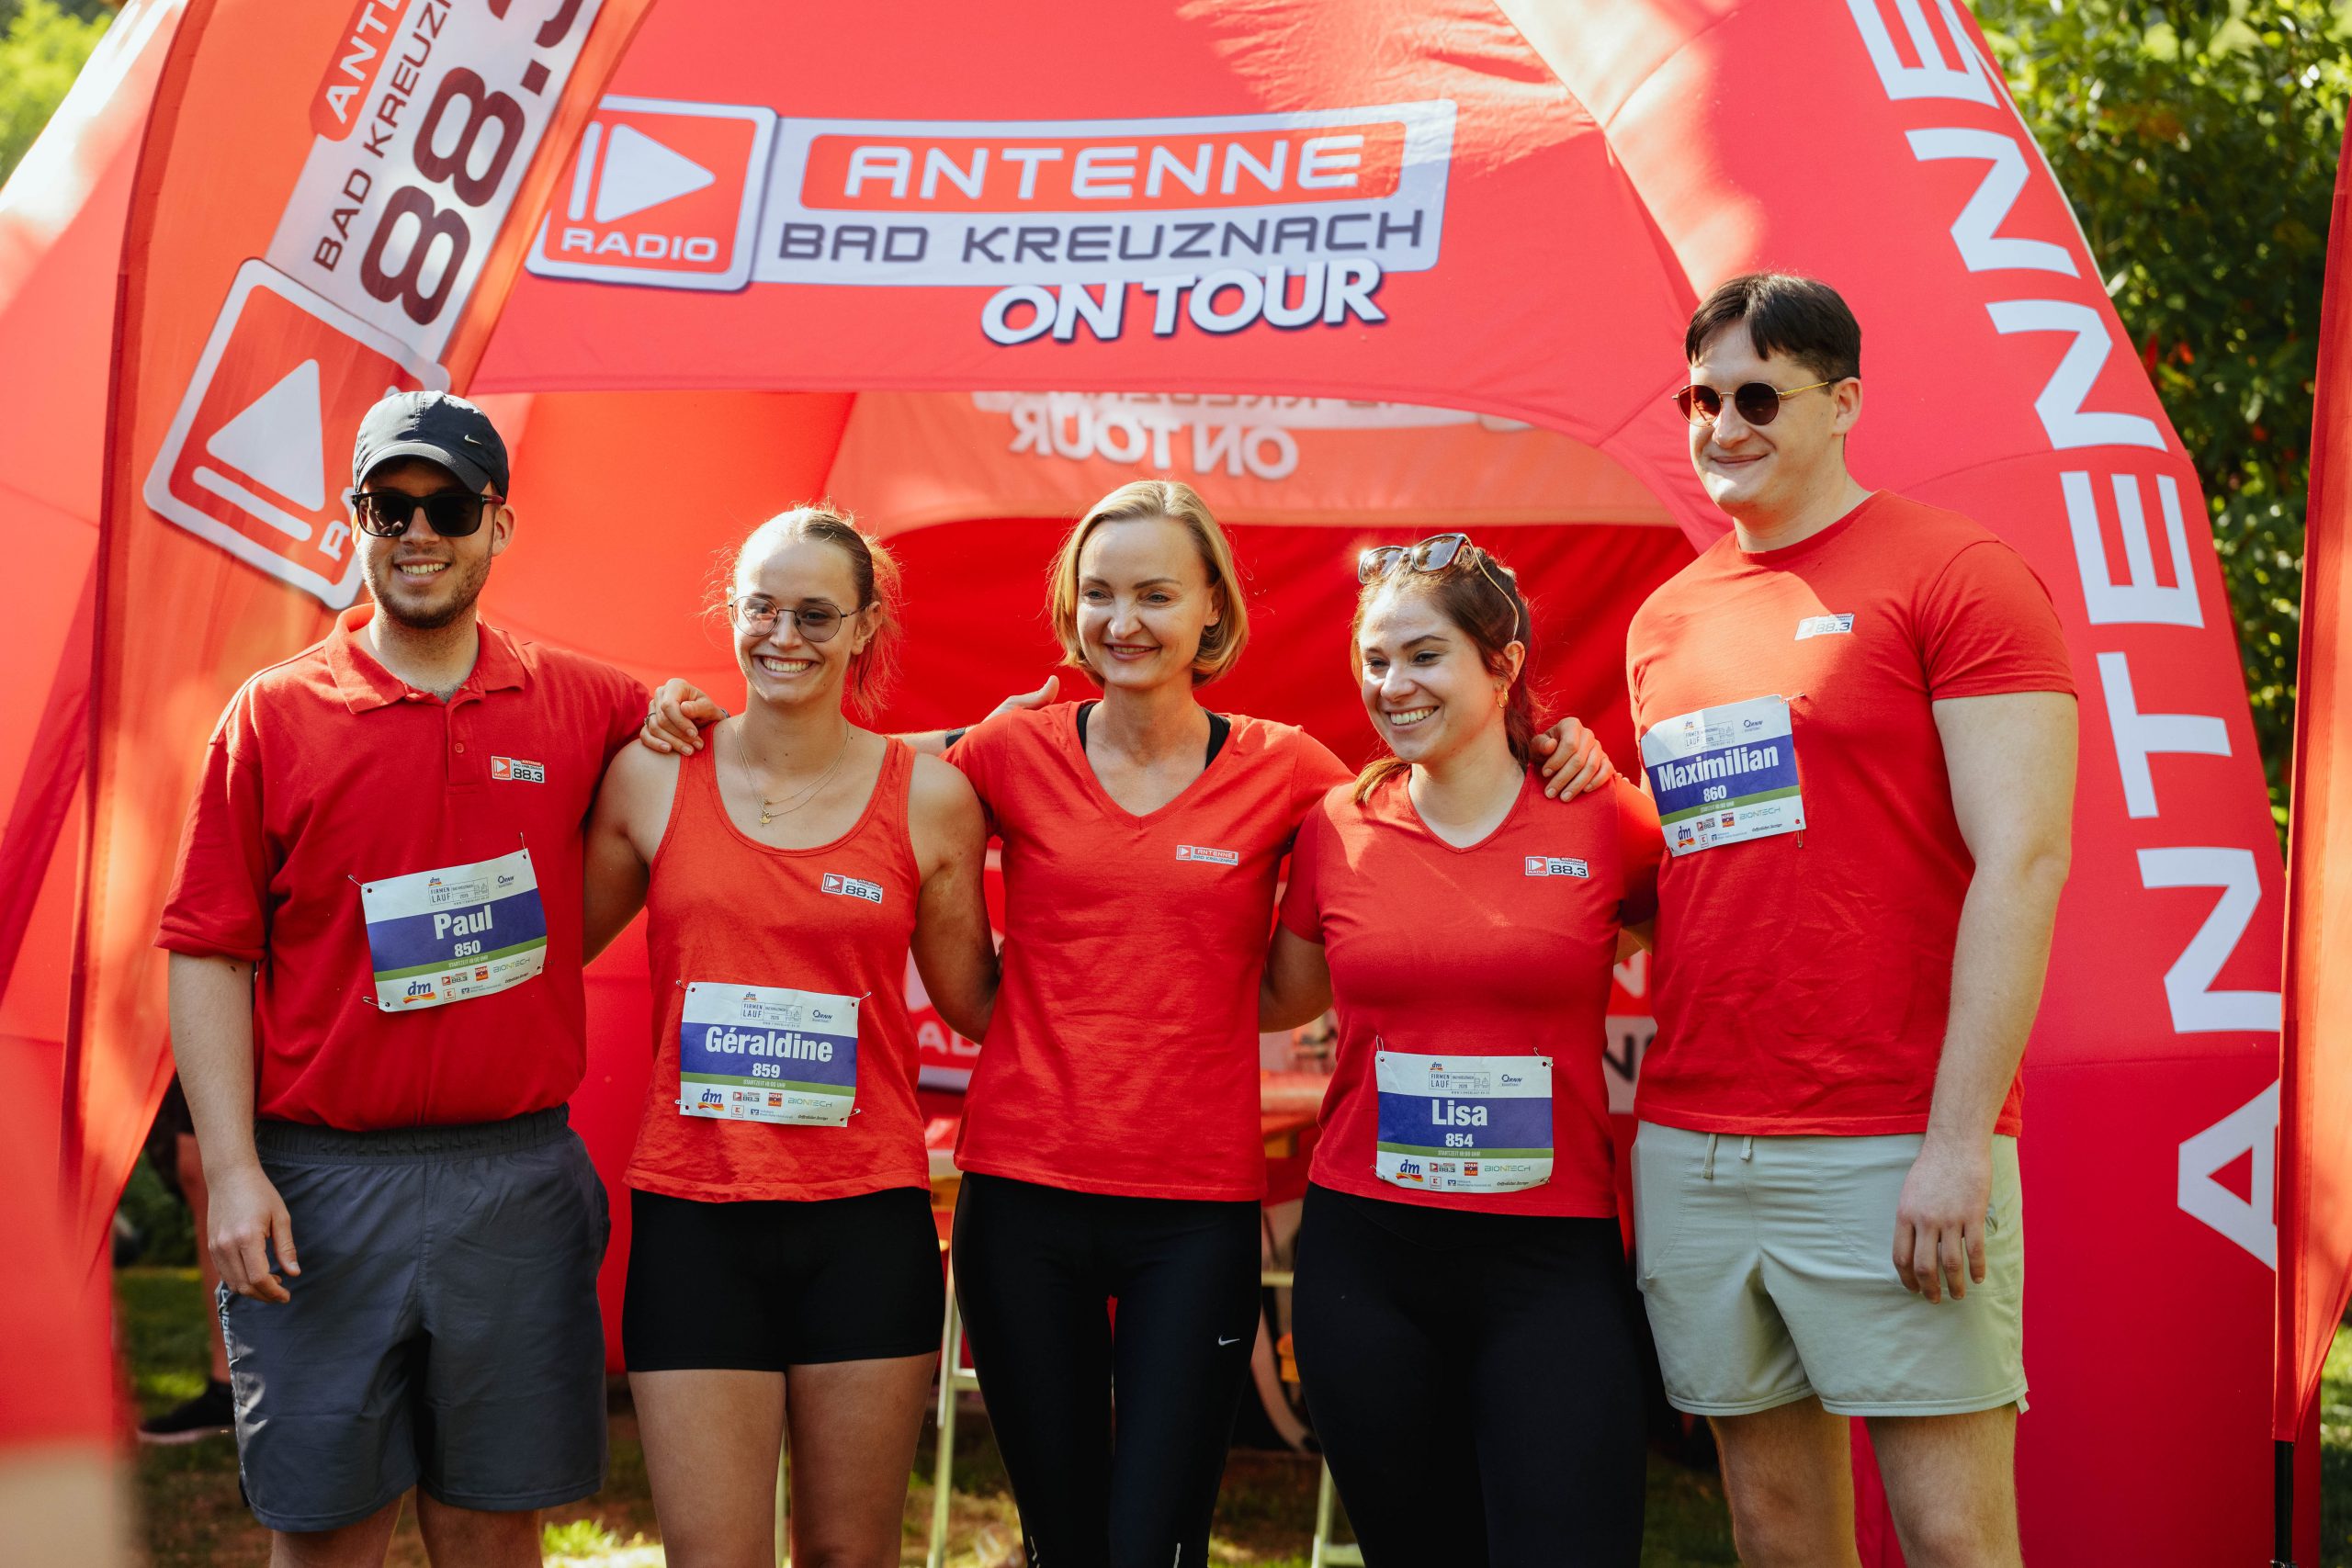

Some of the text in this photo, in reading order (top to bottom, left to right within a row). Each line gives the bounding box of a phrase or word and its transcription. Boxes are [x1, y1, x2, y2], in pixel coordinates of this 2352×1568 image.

[324, 0, 401, 125] ANT
[312, 0, 452, 272] BAD KREUZ
[843, 134, 1365, 200] ANTENNE
[777, 209, 1423, 264] BAD KREUZNACH
[561, 228, 718, 263] RADIO
[979, 257, 1388, 346] ON TOUR
[1815, 622, 1850, 633] 88.3
[1849, 0, 2282, 1271] ANTENNE
[514, 768, 543, 782] 88.3
[1657, 745, 1780, 792] Maximilian
[1702, 784, 1727, 803] 860
[1678, 825, 1692, 840] dm
[1197, 849, 1233, 859] ANTENNE
[1550, 864, 1587, 876] 88.3
[429, 876, 441, 885] dm
[430, 886, 450, 896] FIRMEN
[431, 893, 451, 904] LAUF
[845, 885, 881, 902] 88.3
[433, 904, 493, 941] Paul
[454, 939, 481, 957] 850
[493, 957, 531, 974] BIONTECH
[407, 980, 432, 997] dm
[742, 1009, 762, 1019] LAUF
[705, 1026, 833, 1062] Géraldine
[752, 1062, 781, 1078] 859
[1430, 1079, 1450, 1089] LAUF
[701, 1088, 722, 1103] dm
[787, 1097, 832, 1109] BIONTECH
[1431, 1099, 1488, 1126] Lisa
[1445, 1133, 1474, 1148] 854
[1399, 1158, 1420, 1175] dm
